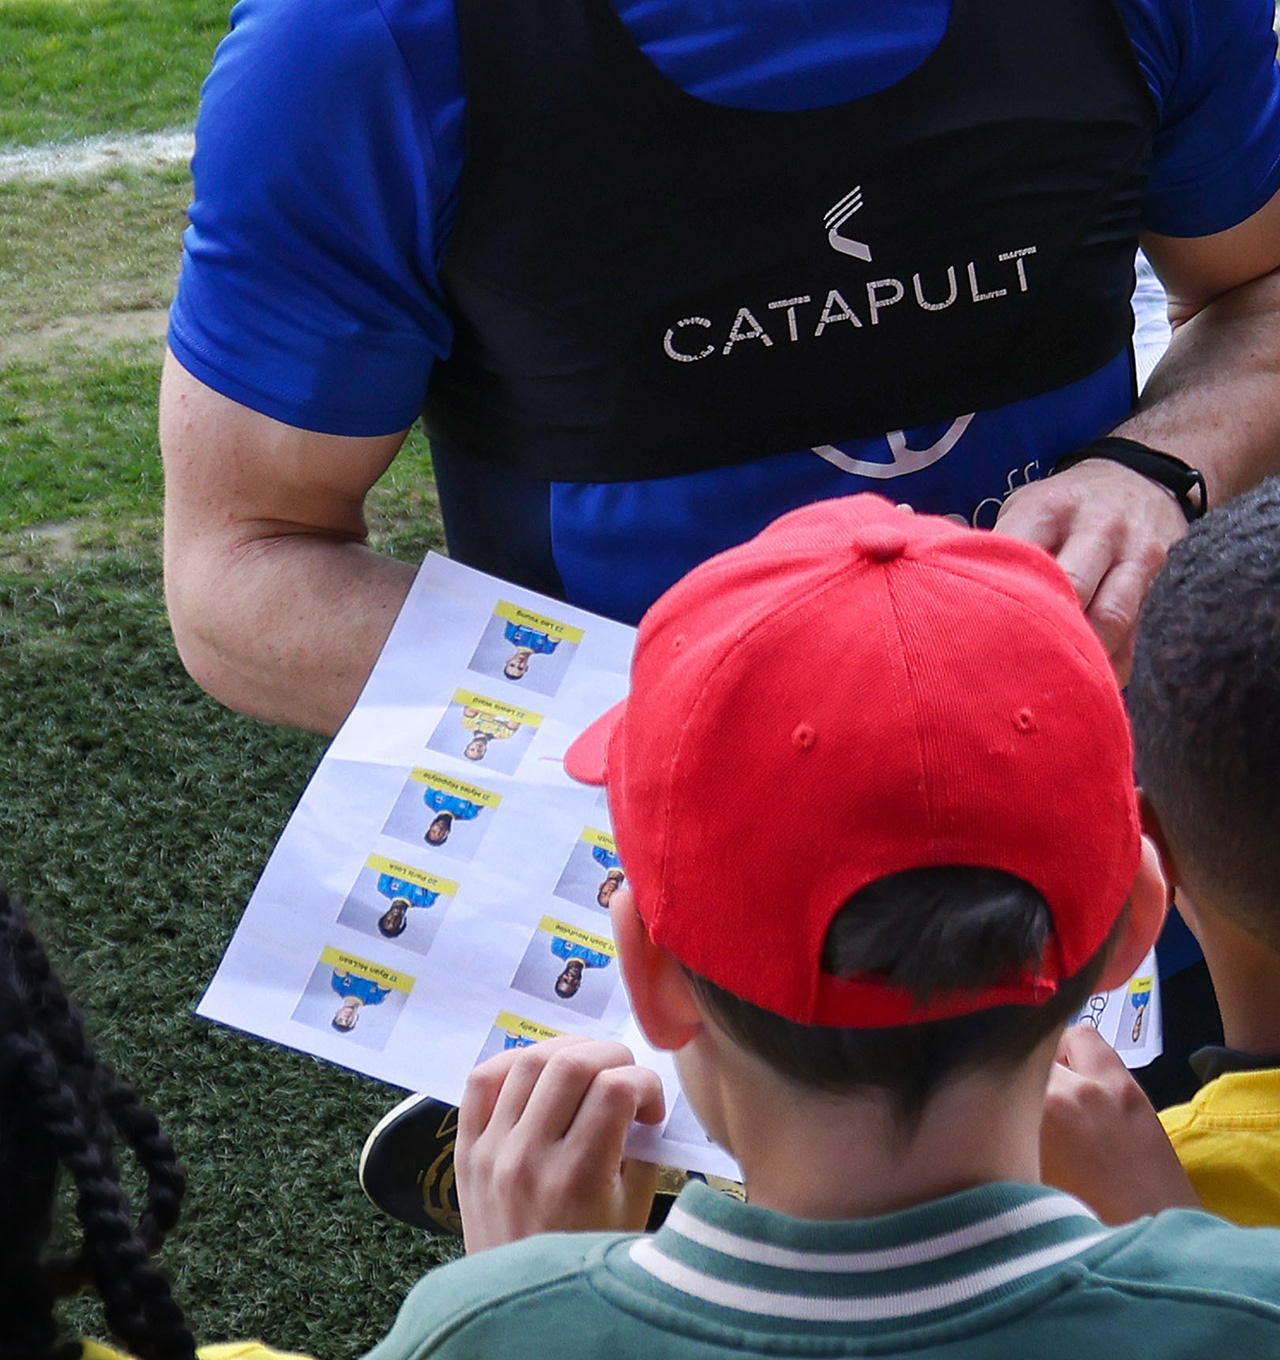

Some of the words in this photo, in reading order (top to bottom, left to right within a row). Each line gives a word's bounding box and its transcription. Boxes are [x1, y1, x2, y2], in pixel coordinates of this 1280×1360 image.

[663, 247, 1037, 363] CATAPULT
[471, 696, 493, 708] Ward
[588, 935, 608, 949] Josh
[336, 954, 368, 971] McLean
[367, 965, 389, 979] Ryan
[517, 1020, 538, 1034] Kelly
